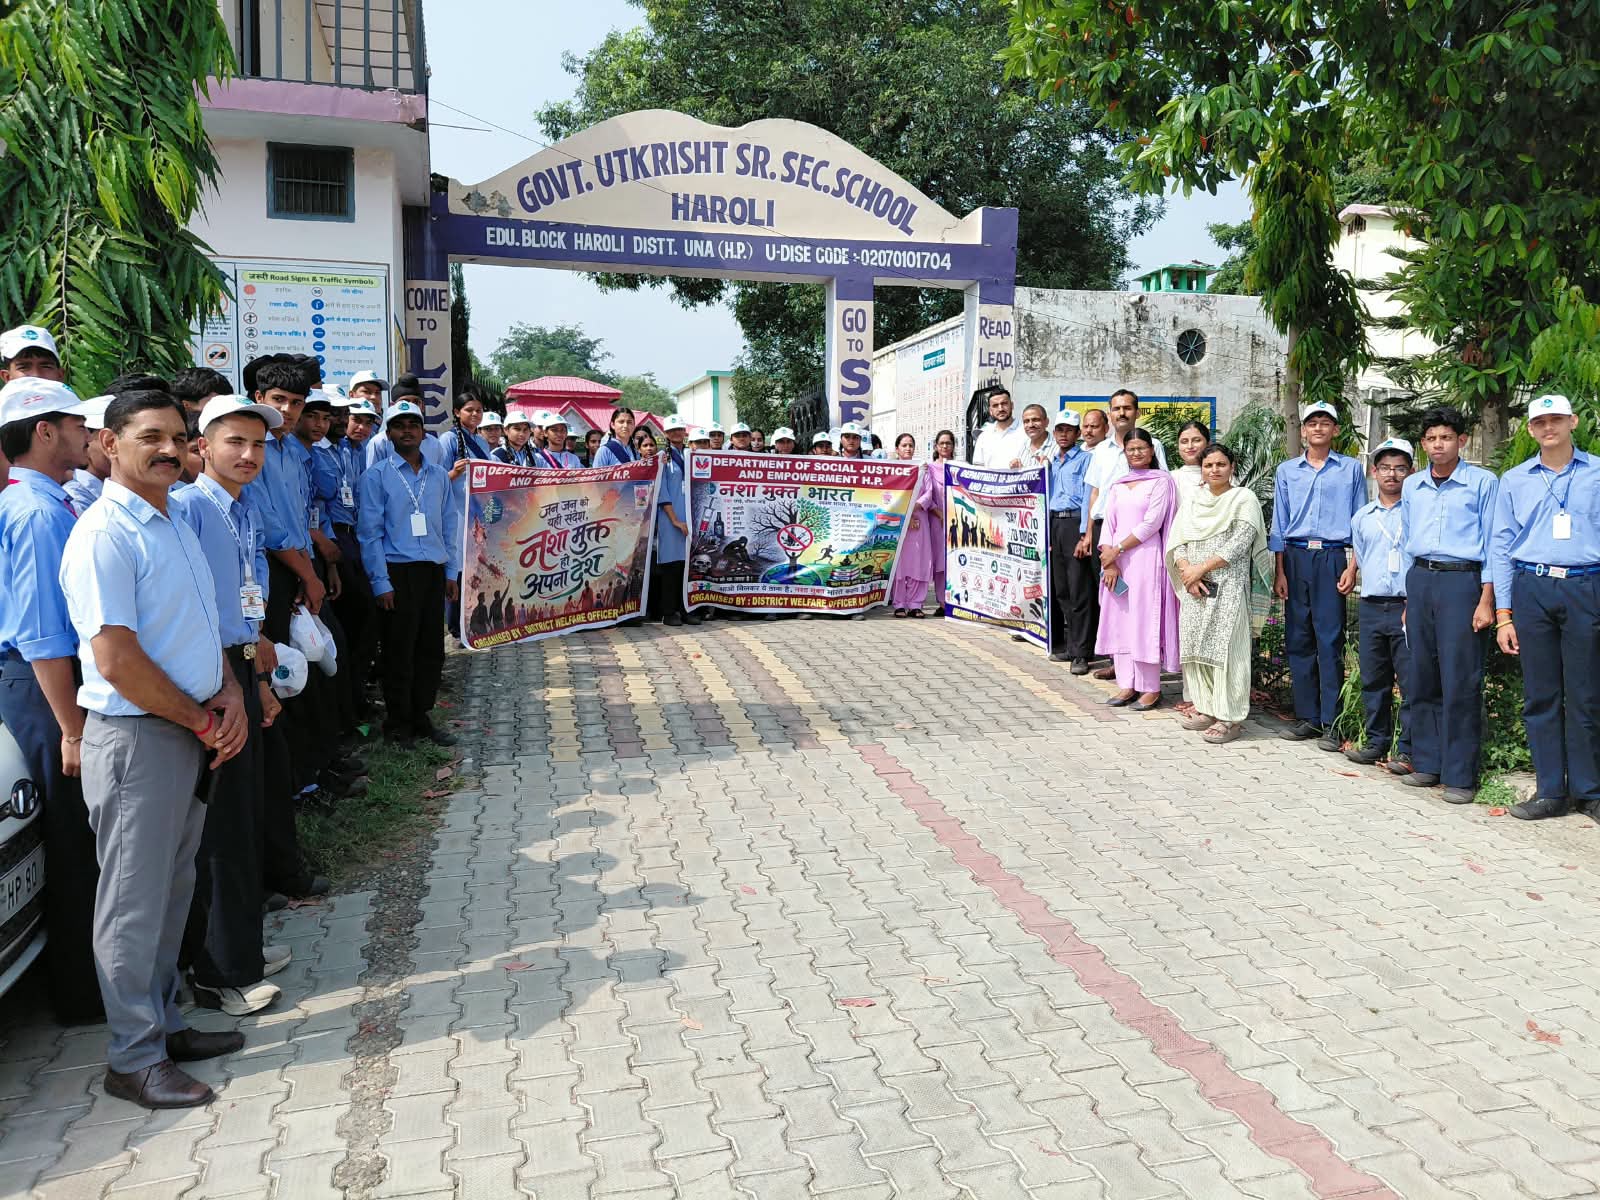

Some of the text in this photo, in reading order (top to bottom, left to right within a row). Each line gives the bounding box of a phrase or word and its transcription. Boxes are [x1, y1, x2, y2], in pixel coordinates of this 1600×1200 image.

[517, 141, 919, 236] GOVT. UTKRISHT SR. SEC. SCHOOL
[671, 193, 775, 228] HAROLI
[486, 226, 520, 247] EDU.
[521, 229, 567, 250] BLOCK
[574, 234, 625, 253] HAROLI
[633, 236, 678, 255] DISTT.
[684, 239, 715, 258] UNA
[718, 240, 753, 260] (H.P.)
[765, 243, 812, 263] U-DISE
[815, 247, 850, 265] CODE
[291, 275, 310, 283] Signs
[319, 276, 342, 284] Traffic
[344, 277, 374, 285] Symbols
[407, 287, 448, 312] COME
[417, 317, 437, 331] TO
[842, 307, 867, 332] GO
[846, 338, 864, 353] TO
[488, 465, 566, 477] DEPARTMENT
[566, 470, 581, 478] OF
[712, 457, 912, 477] DEPARTMENT OF SOCIAL JUSTICE
[509, 477, 532, 488] AND
[612, 469, 630, 480] H.P.
[738, 470, 884, 486] AND EMPOWERMENT H.P.
[719, 483, 856, 502] नशा मुक्त भारत
[539, 502, 560, 519] जन
[561, 499, 579, 512] जन
[516, 517, 624, 571] नशा मुक्त
[519, 546, 611, 601] अपना देश
[690, 592, 734, 604] ORGANISED
[735, 597, 747, 606] BY
[751, 597, 789, 606] DISTRICT
[790, 597, 827, 608] WELFARE
[828, 597, 857, 608] OFFICER
[524, 620, 554, 635] DISTRICT
[555, 612, 588, 628] WELFARE
[587, 608, 619, 621] OFFICER
[8, 876, 21, 911] HP
[26, 861, 37, 893] 80
